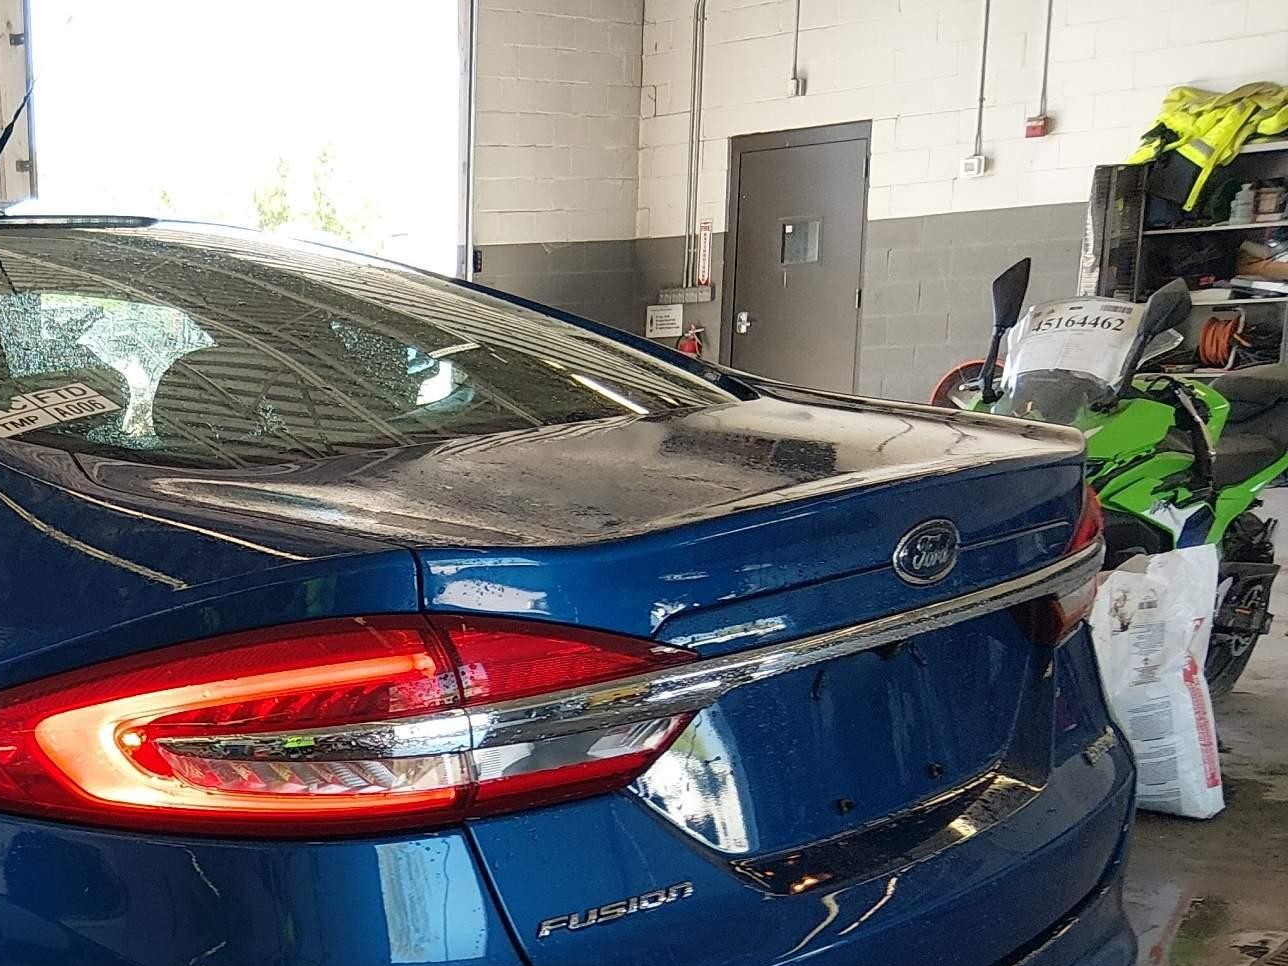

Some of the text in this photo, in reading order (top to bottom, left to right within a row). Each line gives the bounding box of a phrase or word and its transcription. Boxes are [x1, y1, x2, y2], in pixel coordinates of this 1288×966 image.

[1031, 315, 1125, 332] 45164462
[32, 385, 88, 404] FTD
[53, 399, 106, 418] A006
[912, 534, 951, 570] Ford
[537, 881, 695, 939] FUSION
